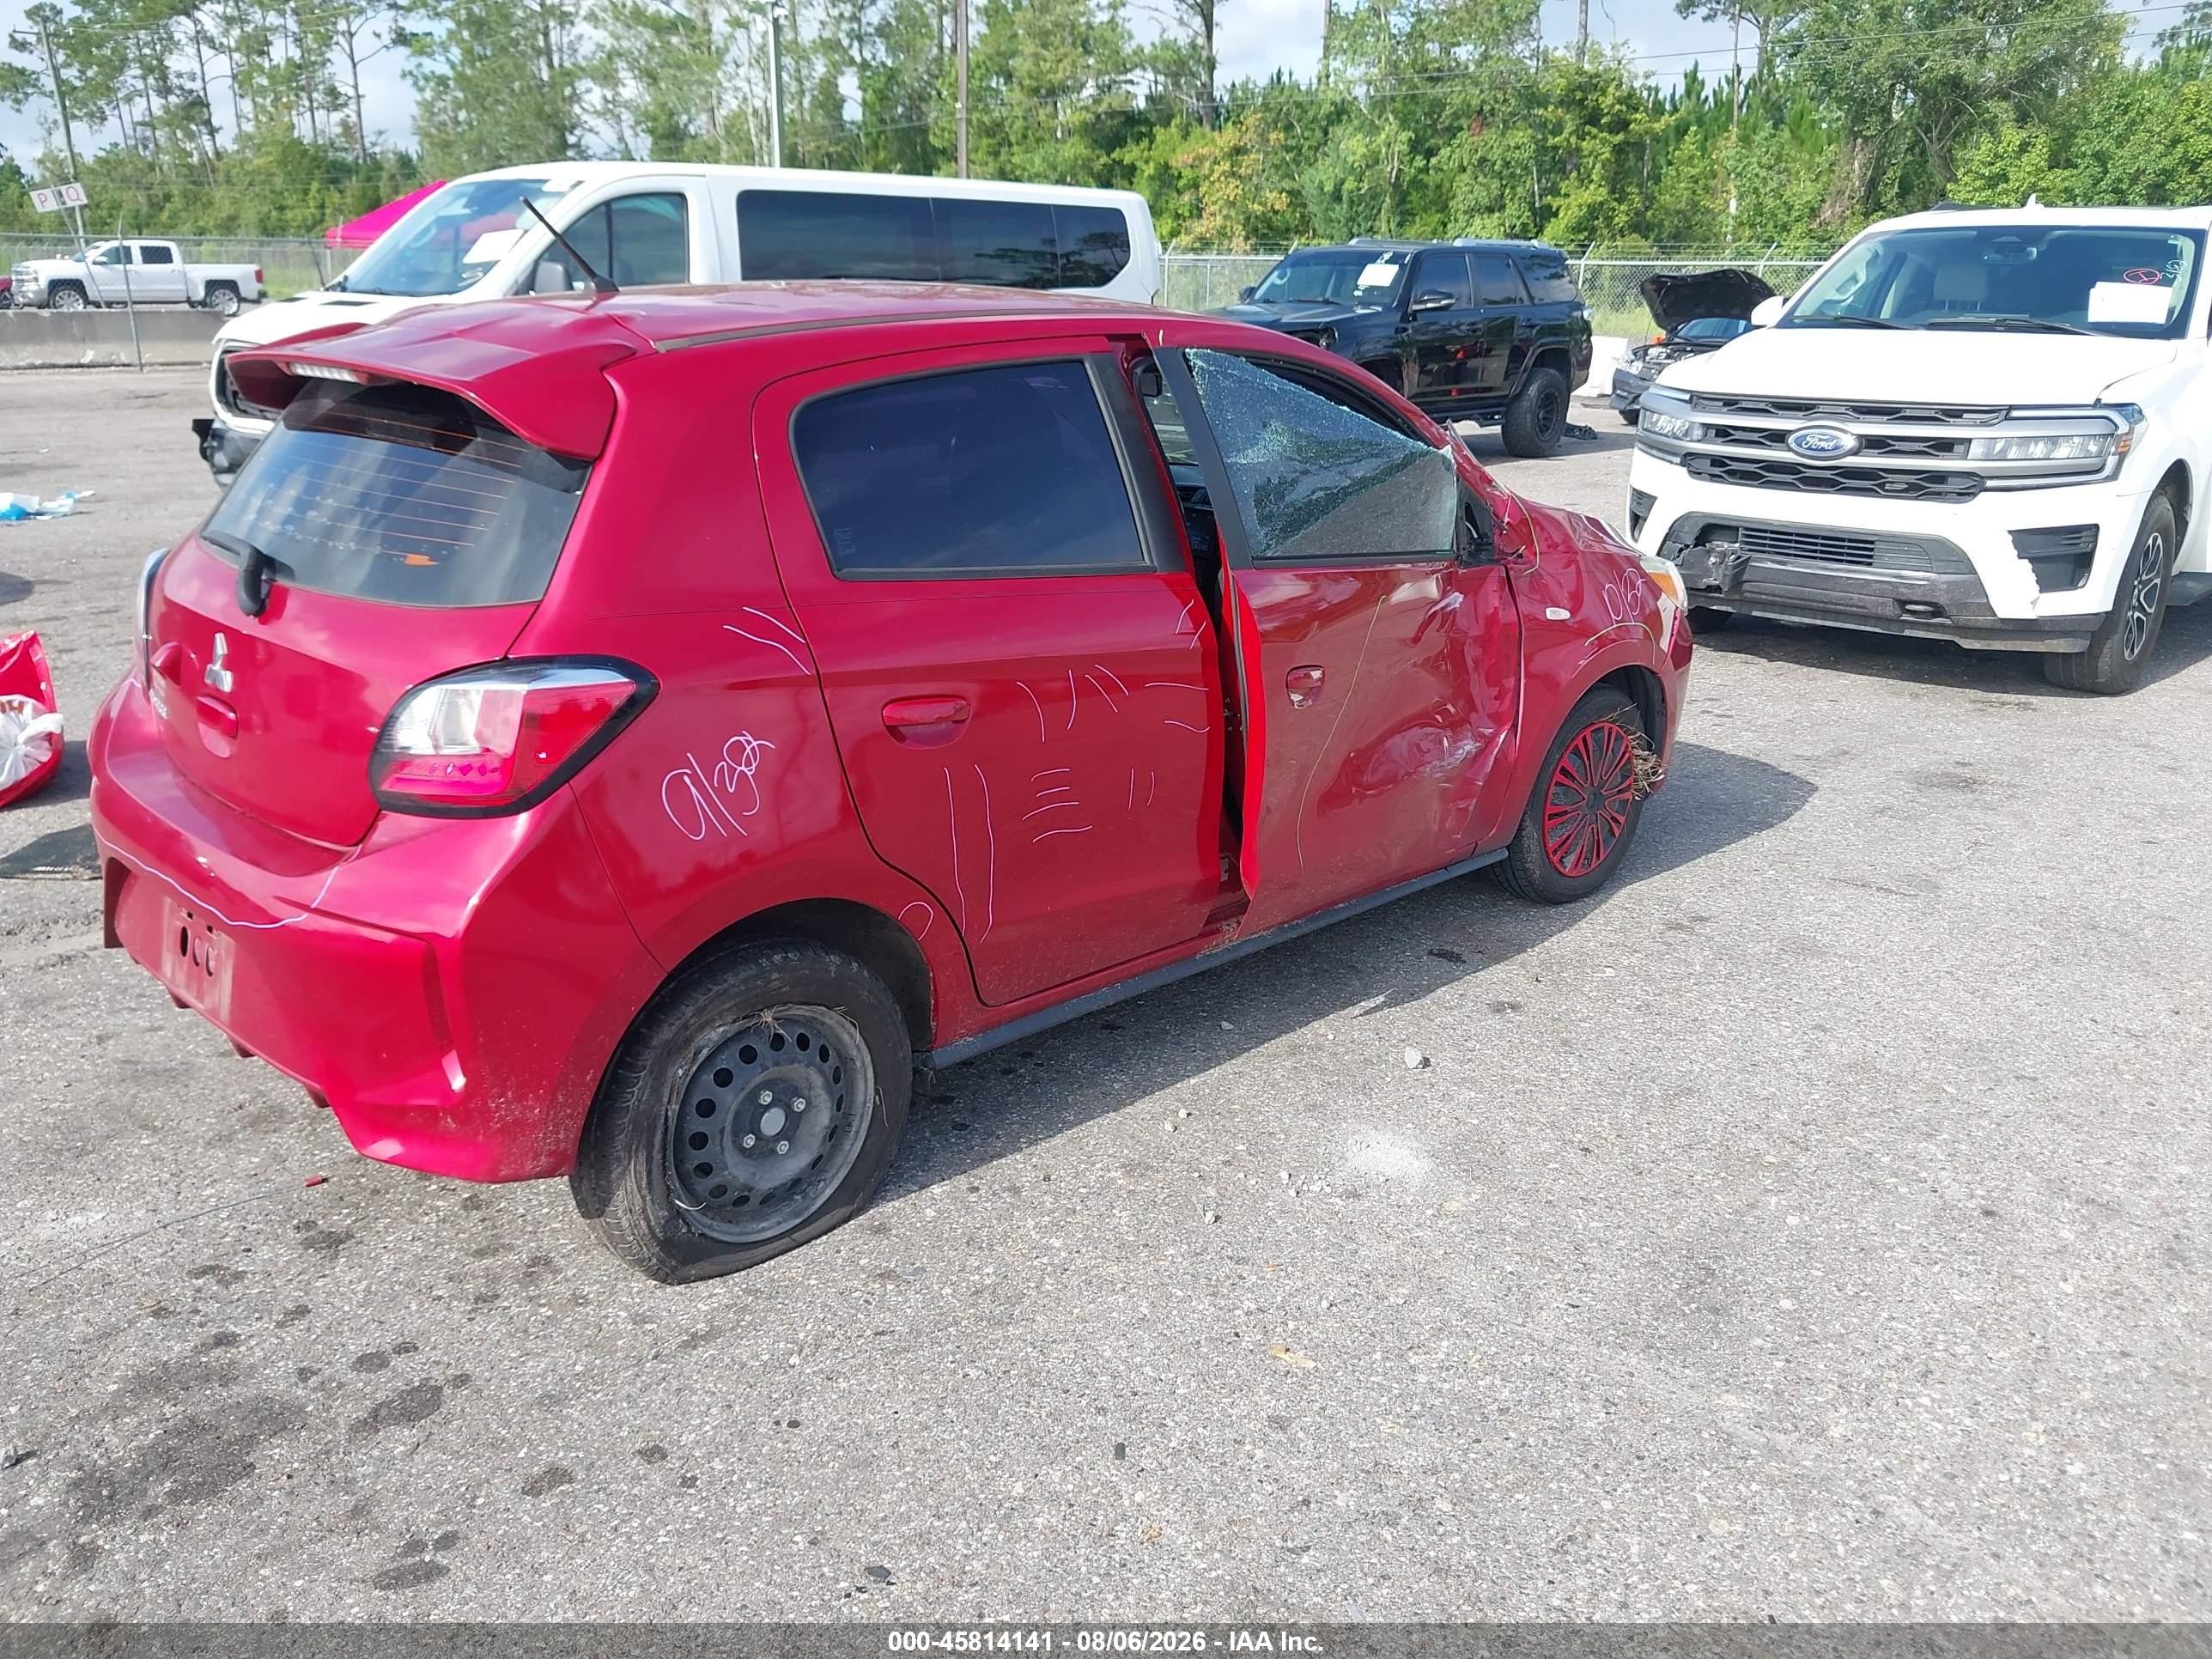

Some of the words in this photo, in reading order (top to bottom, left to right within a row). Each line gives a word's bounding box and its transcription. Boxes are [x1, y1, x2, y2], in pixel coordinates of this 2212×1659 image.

[37, 192, 48, 209] P
[65, 185, 83, 202] Q
[1802, 434, 1838, 450] Ford
